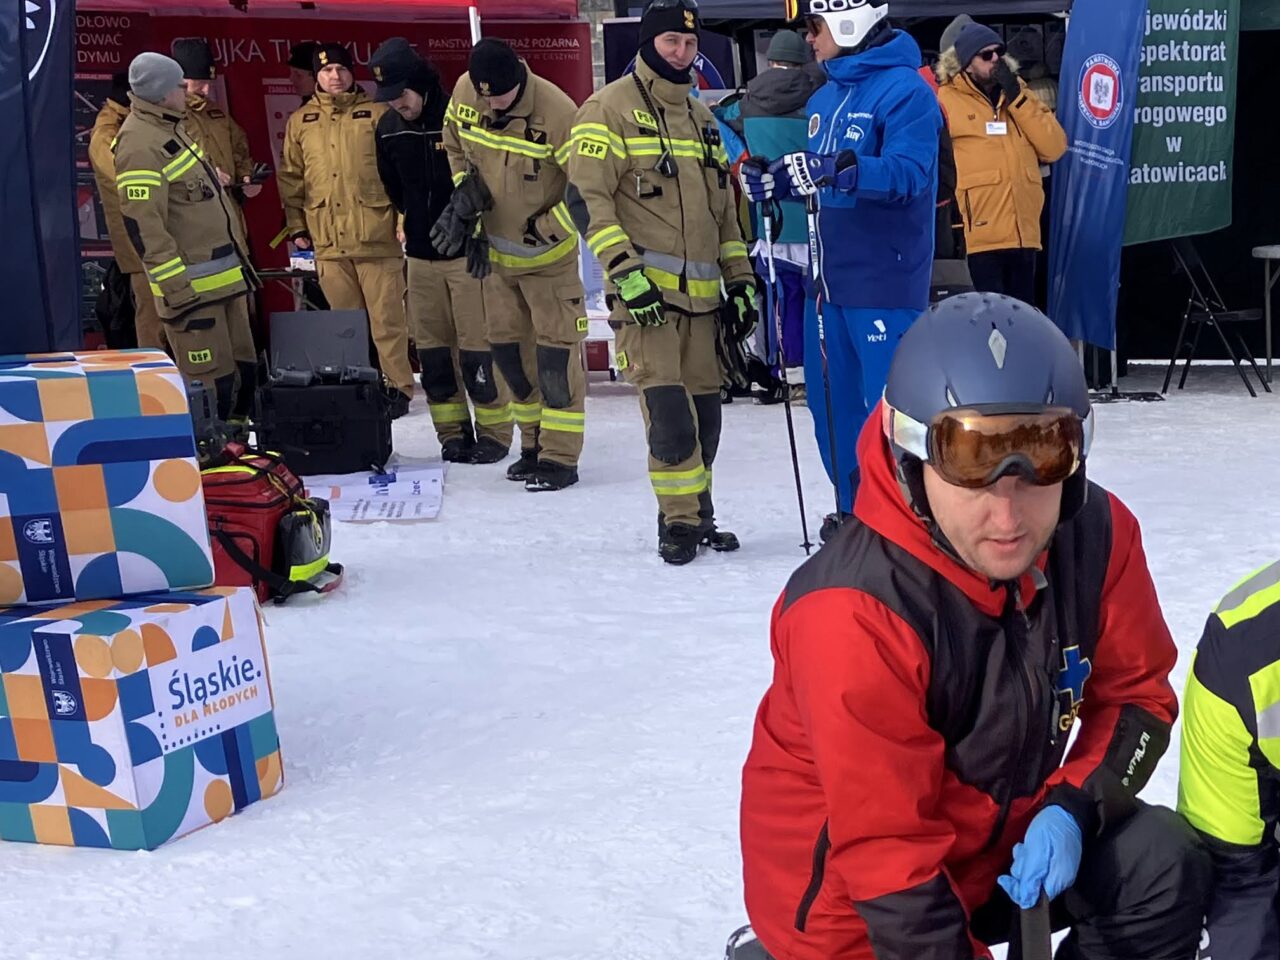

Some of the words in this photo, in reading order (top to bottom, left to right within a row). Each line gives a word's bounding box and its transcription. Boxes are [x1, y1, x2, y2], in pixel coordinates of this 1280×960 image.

[76, 15, 131, 29] DŁOWO
[1144, 8, 1227, 36] jewódzki
[428, 37, 471, 48] PAŃSTW
[506, 37, 530, 48] TRAŻ
[77, 51, 121, 64] DYMU
[1140, 40, 1227, 66] spektorat
[1137, 72, 1224, 97] ansportu
[458, 106, 476, 119] PSP
[1133, 105, 1227, 127] rogowego
[580, 141, 604, 155] PSP
[1165, 136, 1183, 153] w
[128, 187, 147, 199] OSP
[817, 314, 825, 340] SPEED
[190, 351, 209, 362] OSP
[168, 655, 261, 710] Śląskie.
[174, 709, 198, 728] DLA
[202, 685, 258, 718] MŁODYCH
